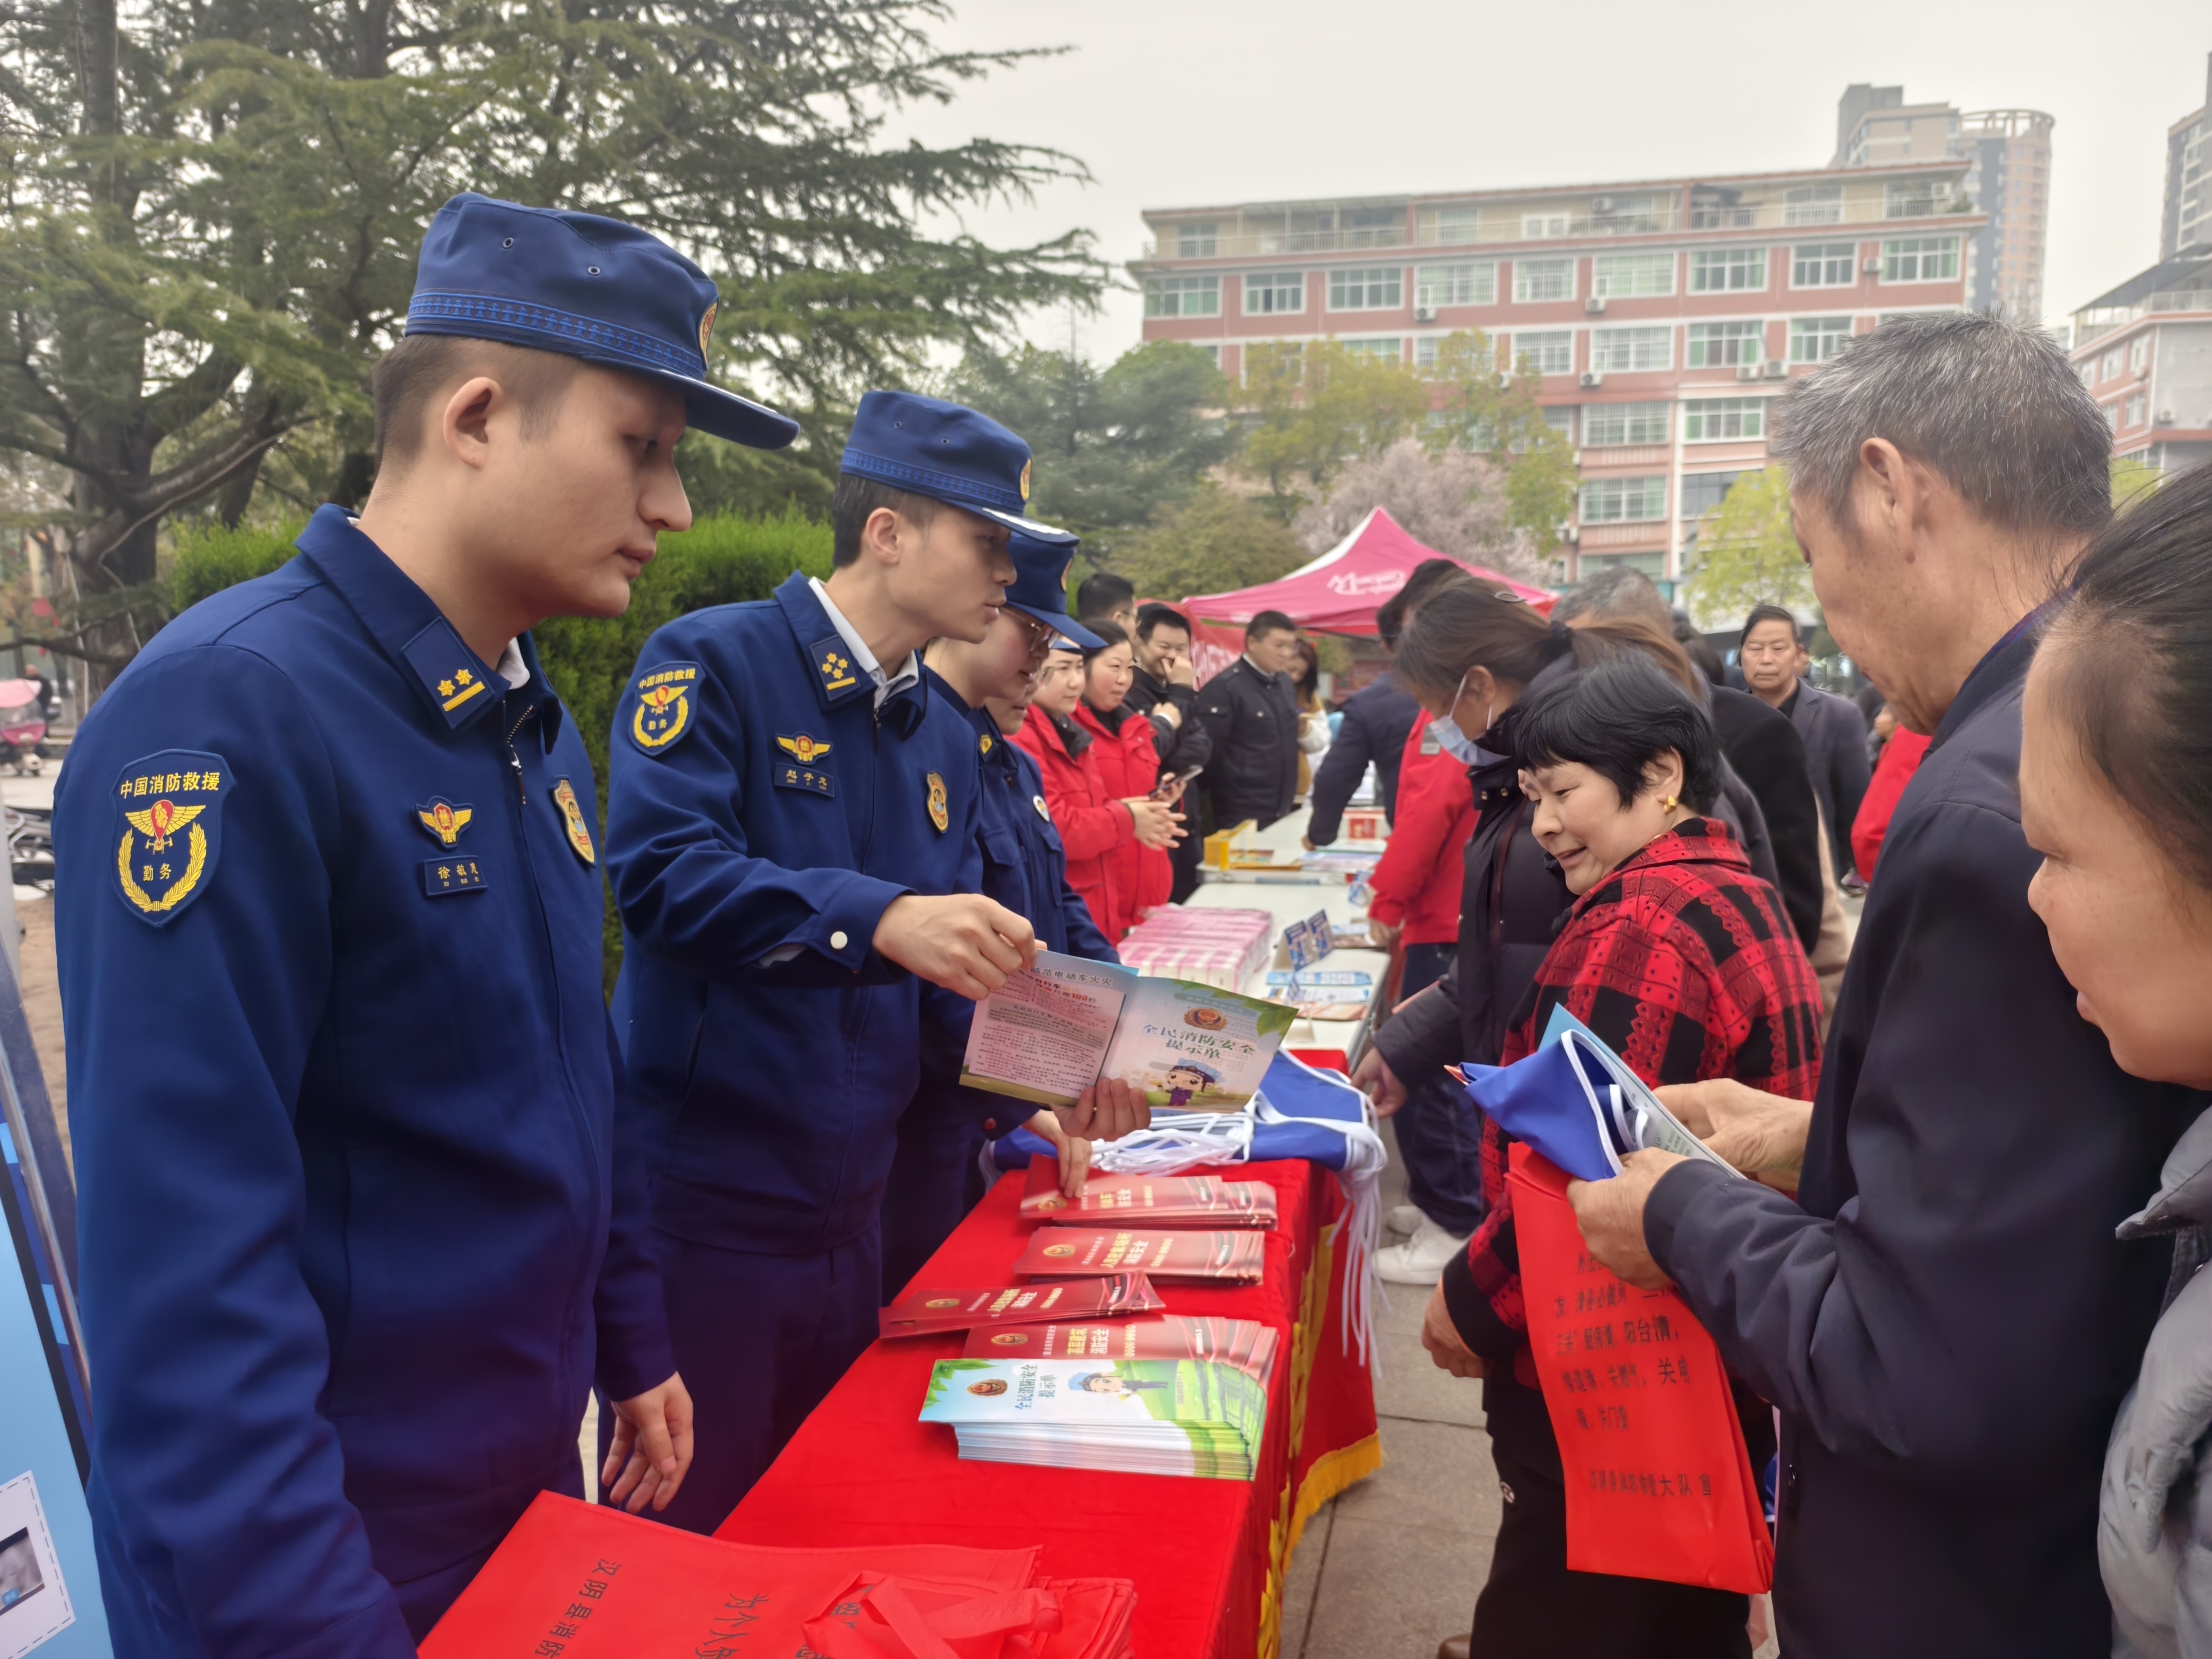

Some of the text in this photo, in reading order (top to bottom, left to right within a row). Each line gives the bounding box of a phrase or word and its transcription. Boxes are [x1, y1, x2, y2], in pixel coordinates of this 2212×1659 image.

[639, 668, 696, 689] 中国消防救援
[119, 771, 220, 799] 中国消防救援
[143, 862, 172, 881] 勤务
[1031, 966, 1113, 986] 防范电动车火灾
[1143, 1024, 1256, 1056] 全民消防安全
[1165, 1038, 1220, 1059] 提示单
[1067, 1327, 1088, 1354] 高层建筑
[1089, 1328, 1109, 1354] 消防安全
[1014, 1364, 1037, 1410] 全民消防安全
[1037, 1374, 1057, 1398] 提示单
[535, 1558, 622, 1658] 汉阴县消防
